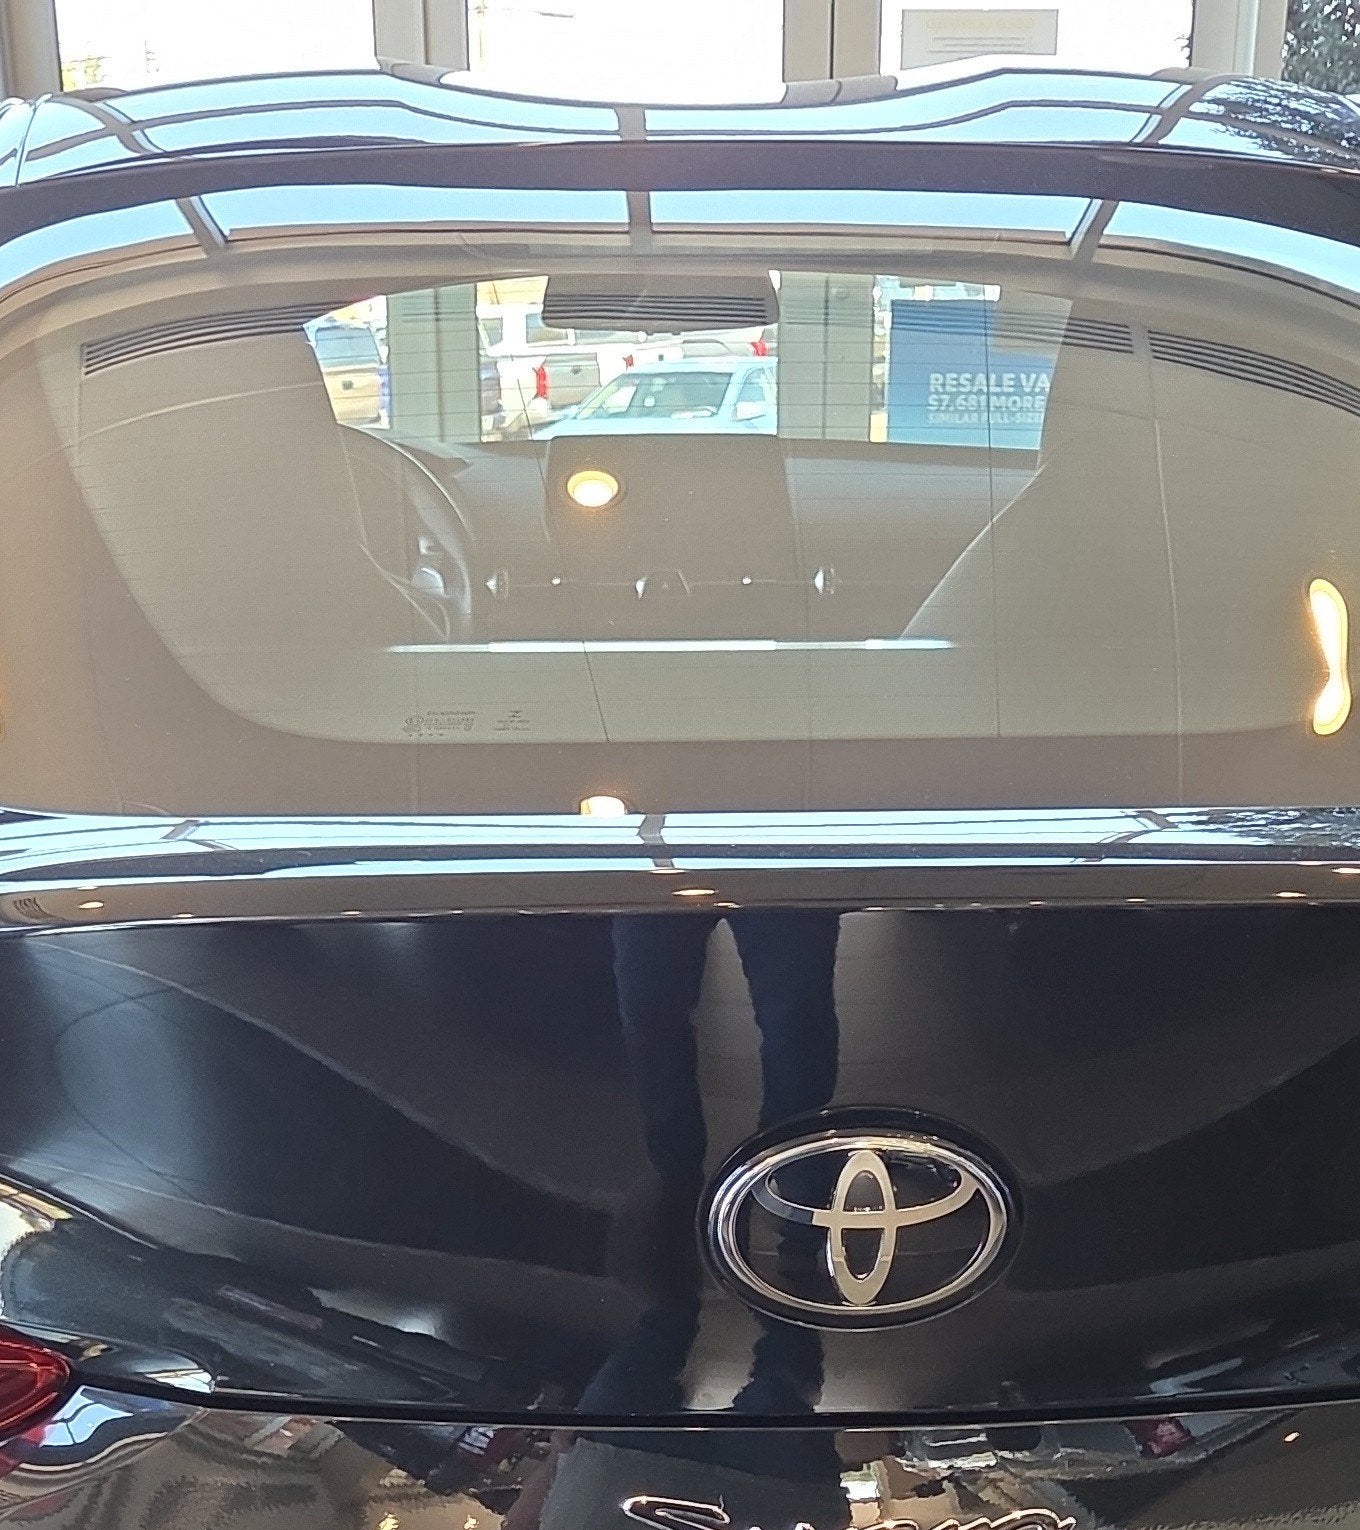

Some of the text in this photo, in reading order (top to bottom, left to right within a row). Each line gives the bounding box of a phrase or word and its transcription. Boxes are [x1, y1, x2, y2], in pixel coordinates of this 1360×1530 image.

[930, 372, 1051, 393] RESALE VA
[989, 395, 1045, 412] MORE
